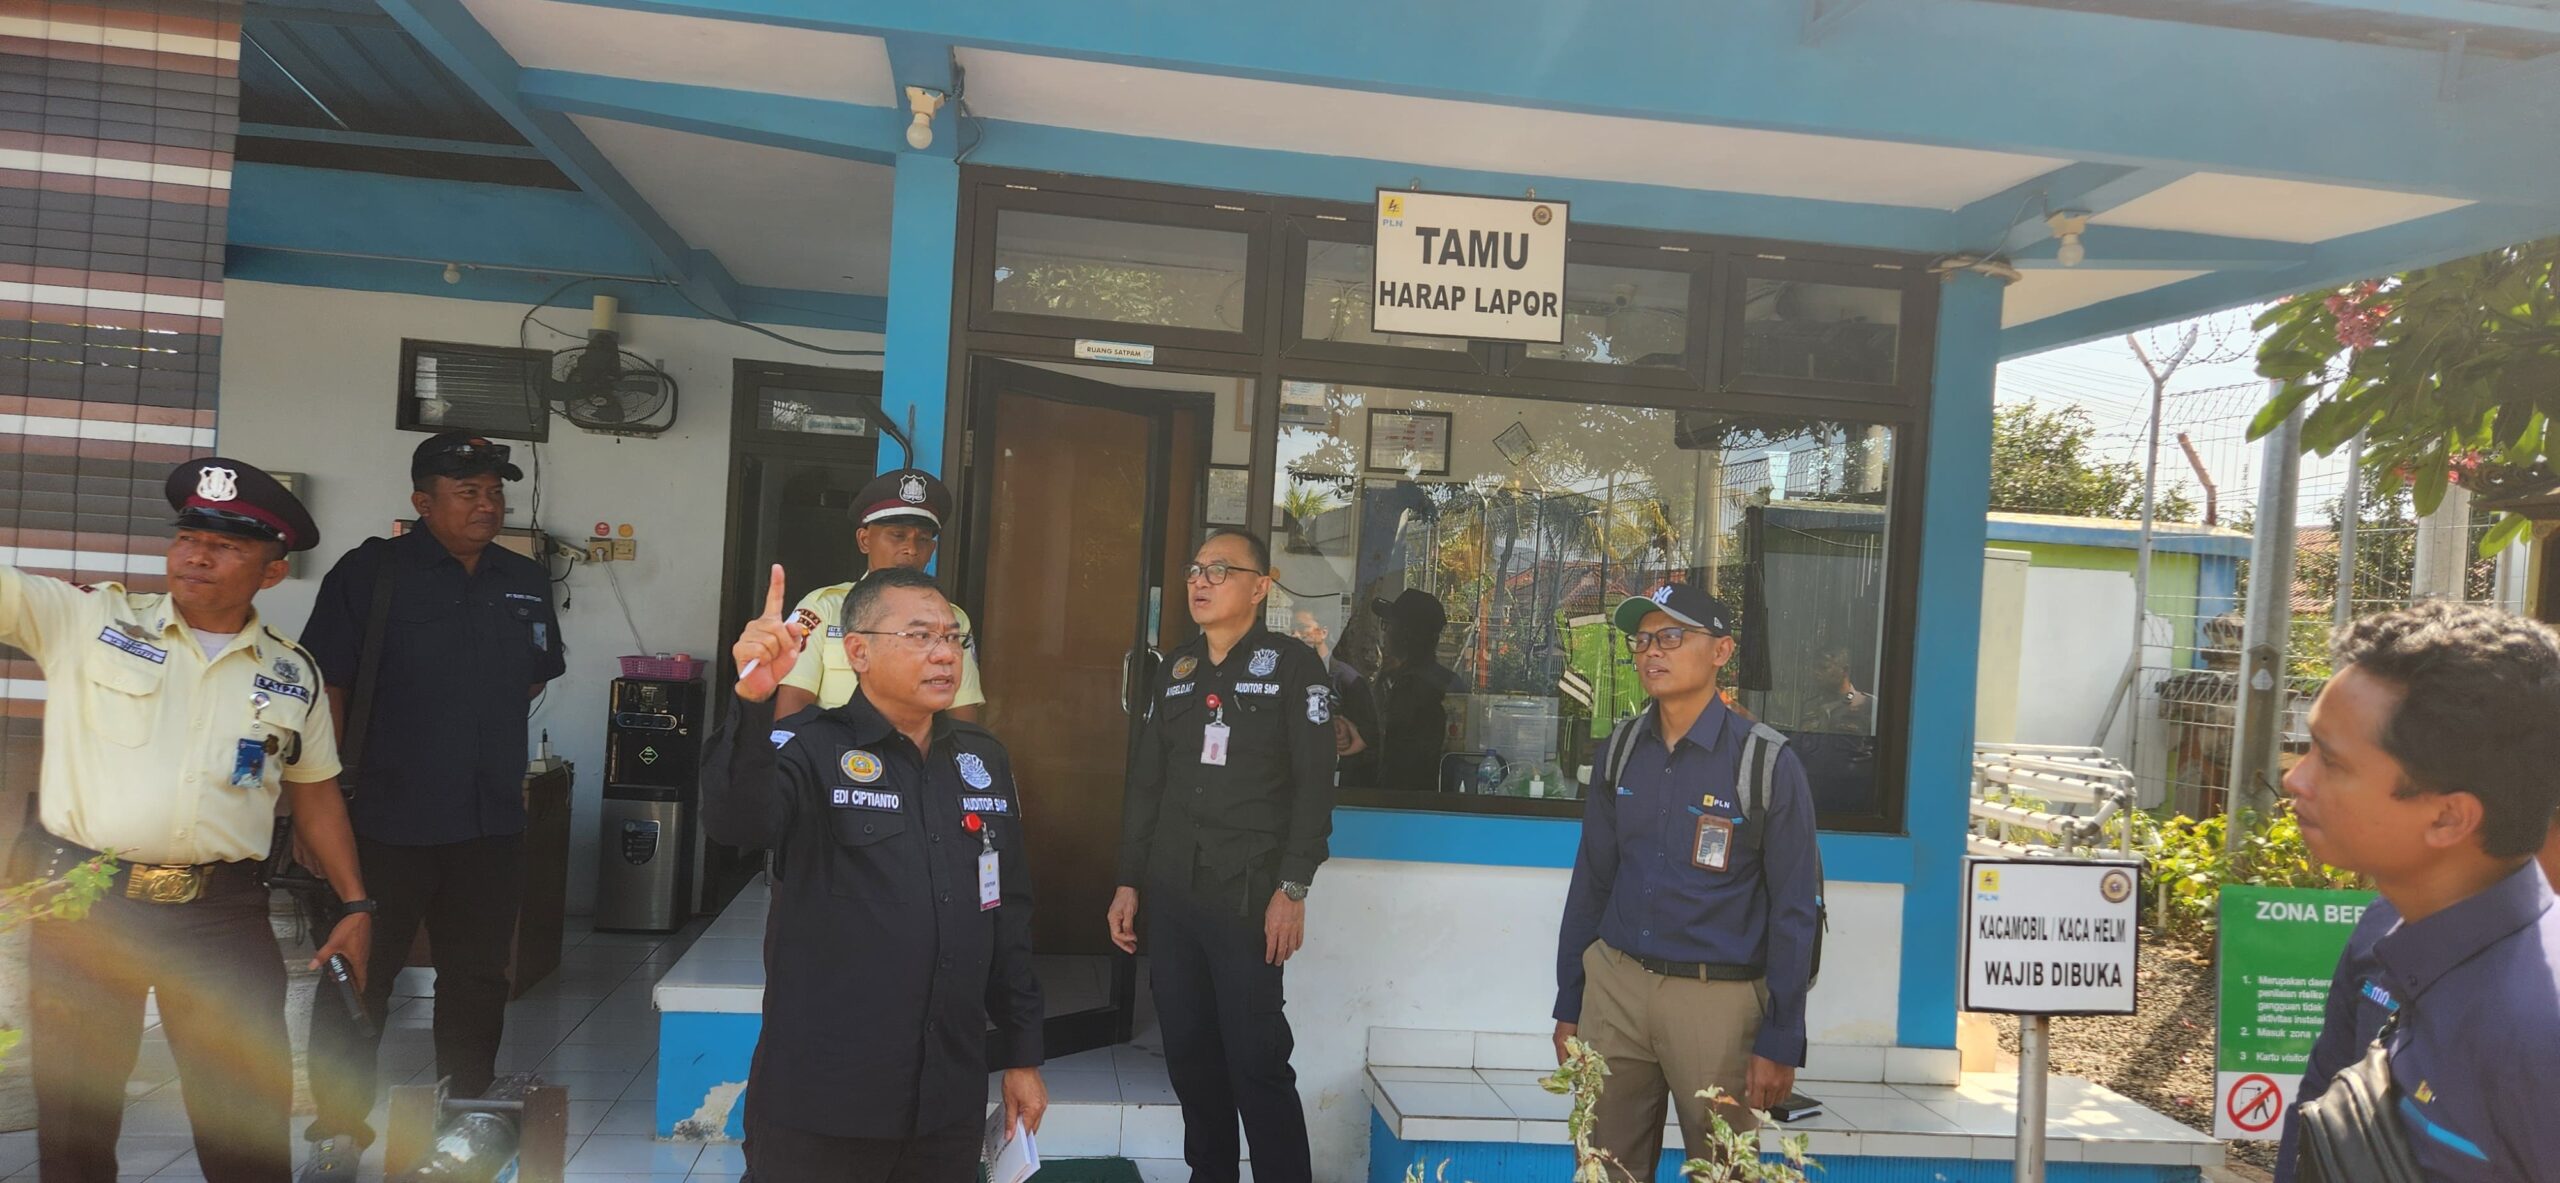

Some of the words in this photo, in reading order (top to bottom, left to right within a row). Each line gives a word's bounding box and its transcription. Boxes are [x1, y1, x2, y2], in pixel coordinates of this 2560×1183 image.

[1382, 218, 1403, 228] PLN
[1416, 226, 1529, 270] TAMU
[1379, 281, 1466, 311] HARAP
[1474, 287, 1558, 317] LAPOR
[1086, 346, 1112, 354] RUANG
[1114, 349, 1141, 357] SATPAM
[1235, 682, 1263, 694] AUDITOR
[1264, 683, 1280, 695] SMP
[833, 789, 849, 804] EDI
[852, 791, 900, 809] CIPTIANTO
[963, 798, 993, 811] AUDITOR
[1714, 799, 1731, 808] PLN
[1977, 893, 1999, 901] PLN
[2256, 901, 2319, 922] ZONA
[1979, 915, 2048, 941] KACAMOBIL
[2058, 917, 2090, 941] KACA
[2094, 918, 2126, 943] HELM
[1985, 961, 2044, 986] WAJIB
[2051, 962, 2122, 987] DIBUKA
[2258, 976, 2306, 986] Merupakan
[2258, 1002, 2301, 1012] gangguan
[2257, 1014, 2293, 1023] aktivitas
[2257, 1028, 2285, 1037] Masuk
[2256, 1052, 2280, 1061] Kartu
